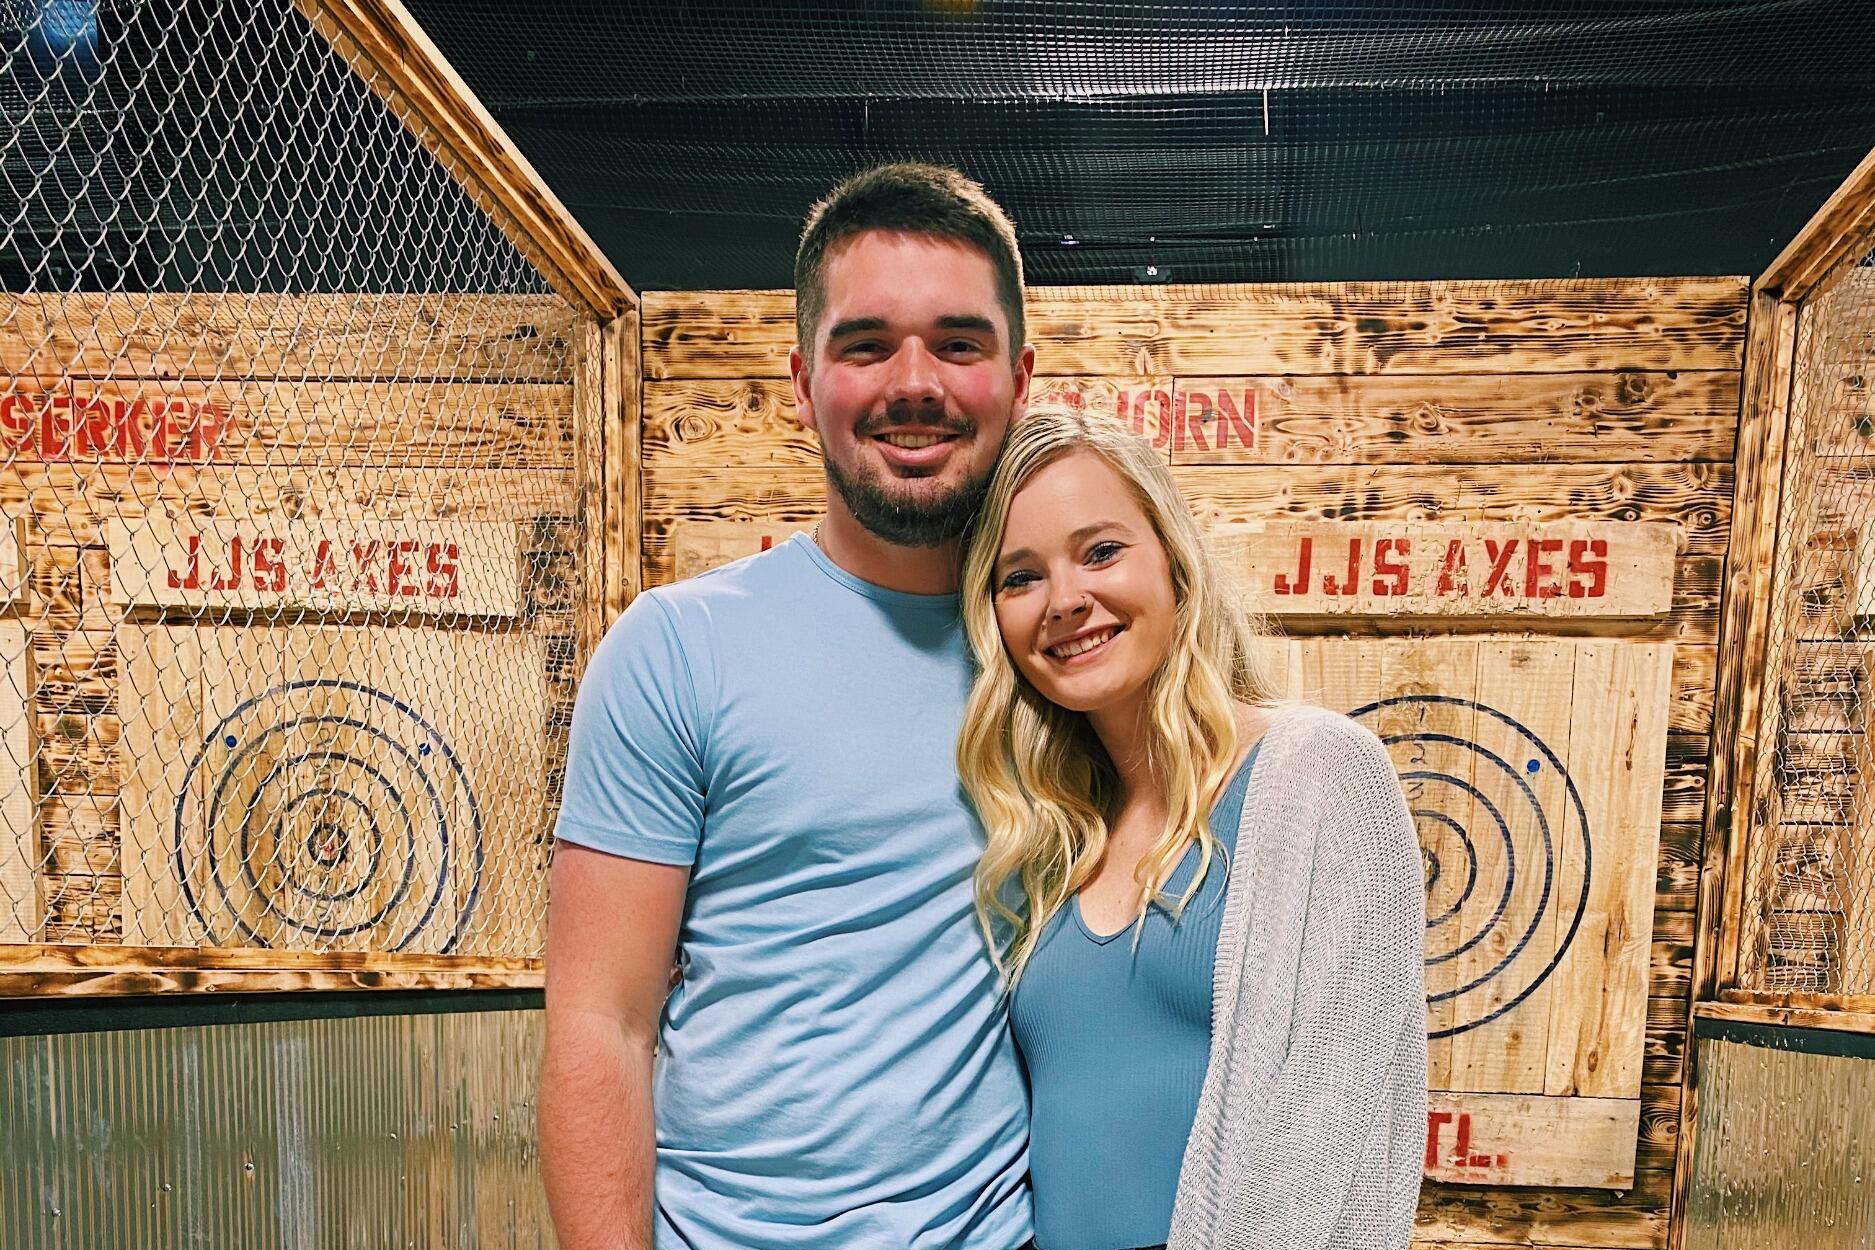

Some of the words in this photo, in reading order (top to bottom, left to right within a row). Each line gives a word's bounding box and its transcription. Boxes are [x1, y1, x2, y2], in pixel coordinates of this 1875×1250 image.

[167, 535, 286, 592] JJS
[310, 540, 460, 598] AXES
[1274, 537, 1411, 596] JJS
[1437, 539, 1608, 598] AXES
